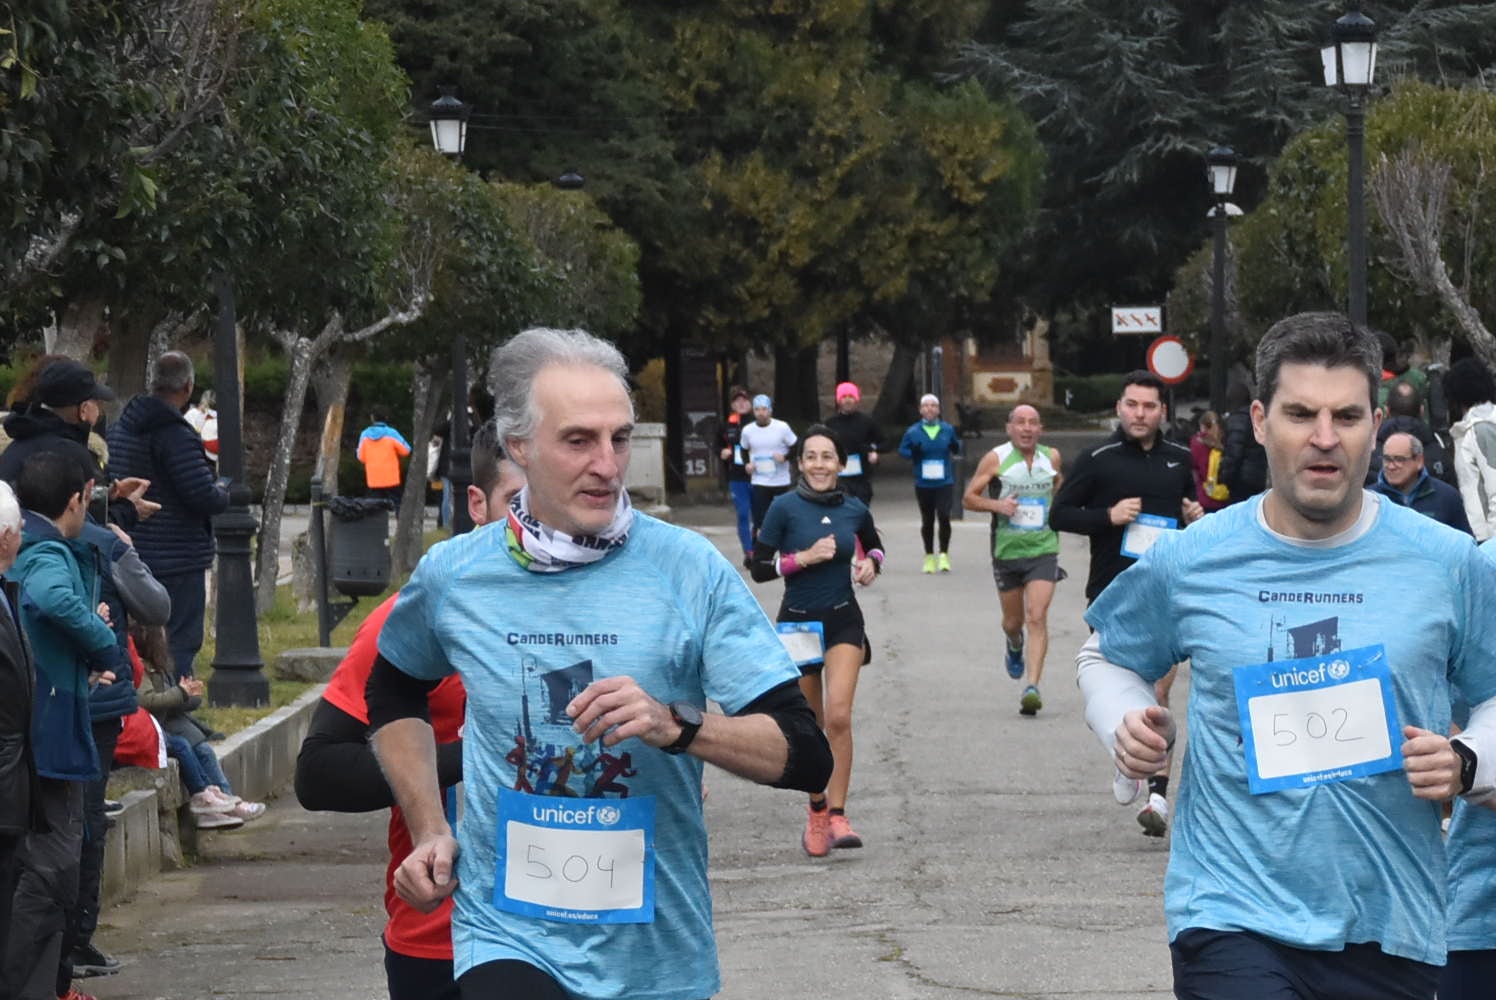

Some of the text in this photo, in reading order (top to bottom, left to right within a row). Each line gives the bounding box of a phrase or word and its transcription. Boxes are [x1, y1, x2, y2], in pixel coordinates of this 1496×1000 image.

[685, 460, 707, 475] 15
[1271, 663, 1326, 688] unicef
[1273, 708, 1366, 746] 502
[533, 805, 596, 824] unicef
[526, 844, 615, 889] 504
